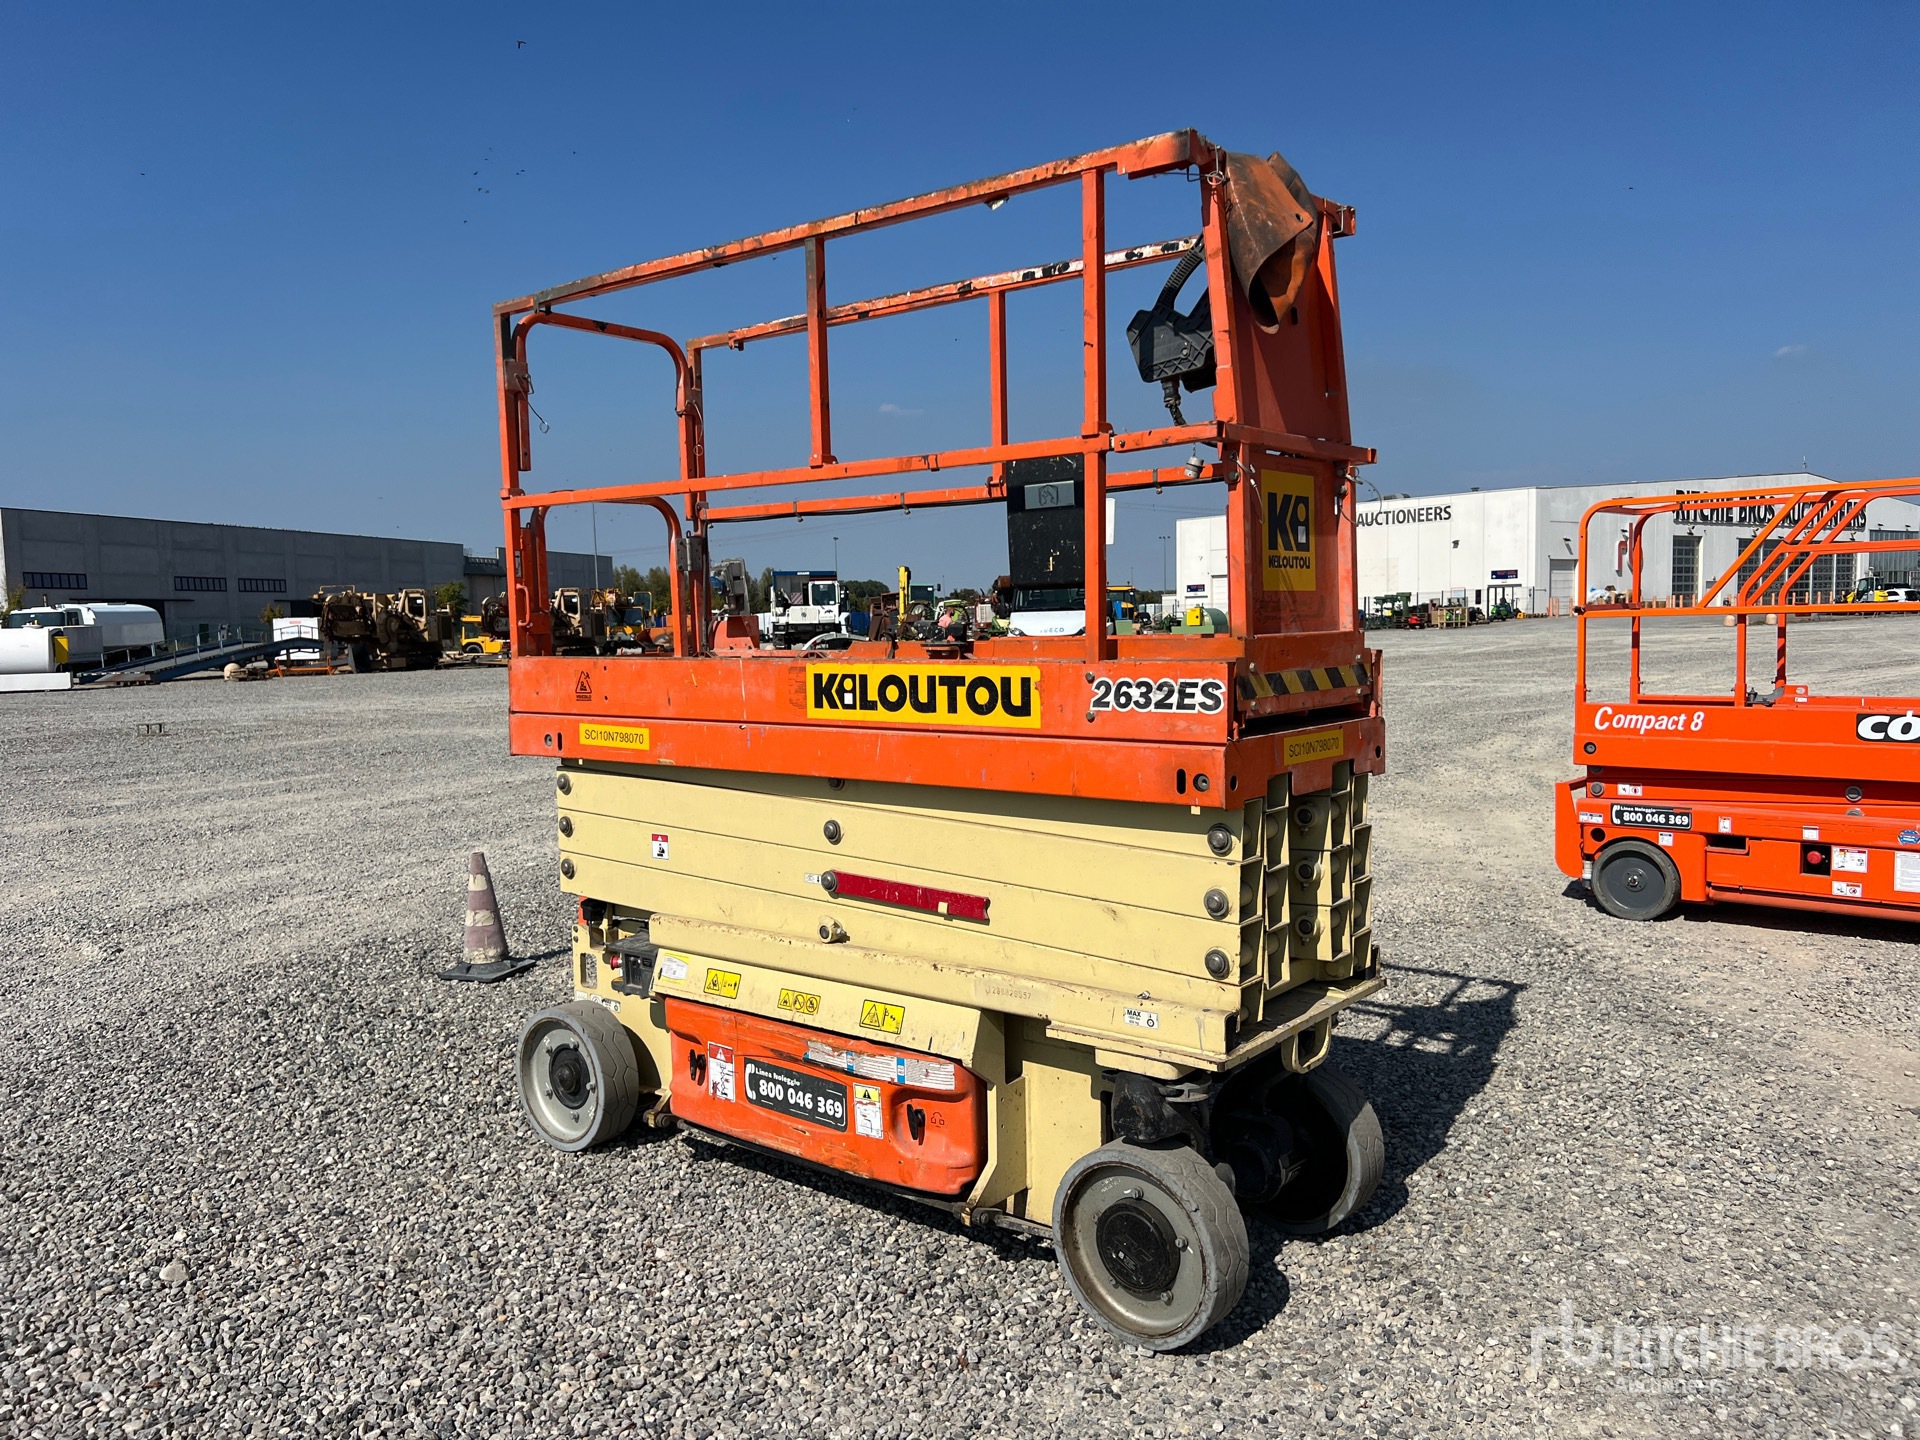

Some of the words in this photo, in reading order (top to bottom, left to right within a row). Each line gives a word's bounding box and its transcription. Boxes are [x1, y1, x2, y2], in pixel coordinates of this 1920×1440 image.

[1357, 505, 1451, 527] AUCTIONEERS
[1091, 678, 1224, 713] 2632ES
[1594, 706, 1687, 735] Compact
[1690, 711, 1705, 732] 8
[584, 729, 644, 744] SCI10N798070
[1288, 736, 1340, 758] SCI10N798070
[1623, 812, 1643, 822] 800
[1645, 813, 1666, 824] 046
[1668, 815, 1689, 825] 369
[1126, 1009, 1142, 1018] MAX
[759, 1079, 784, 1101] 800
[787, 1087, 813, 1110] 046
[817, 1096, 843, 1118] 369
